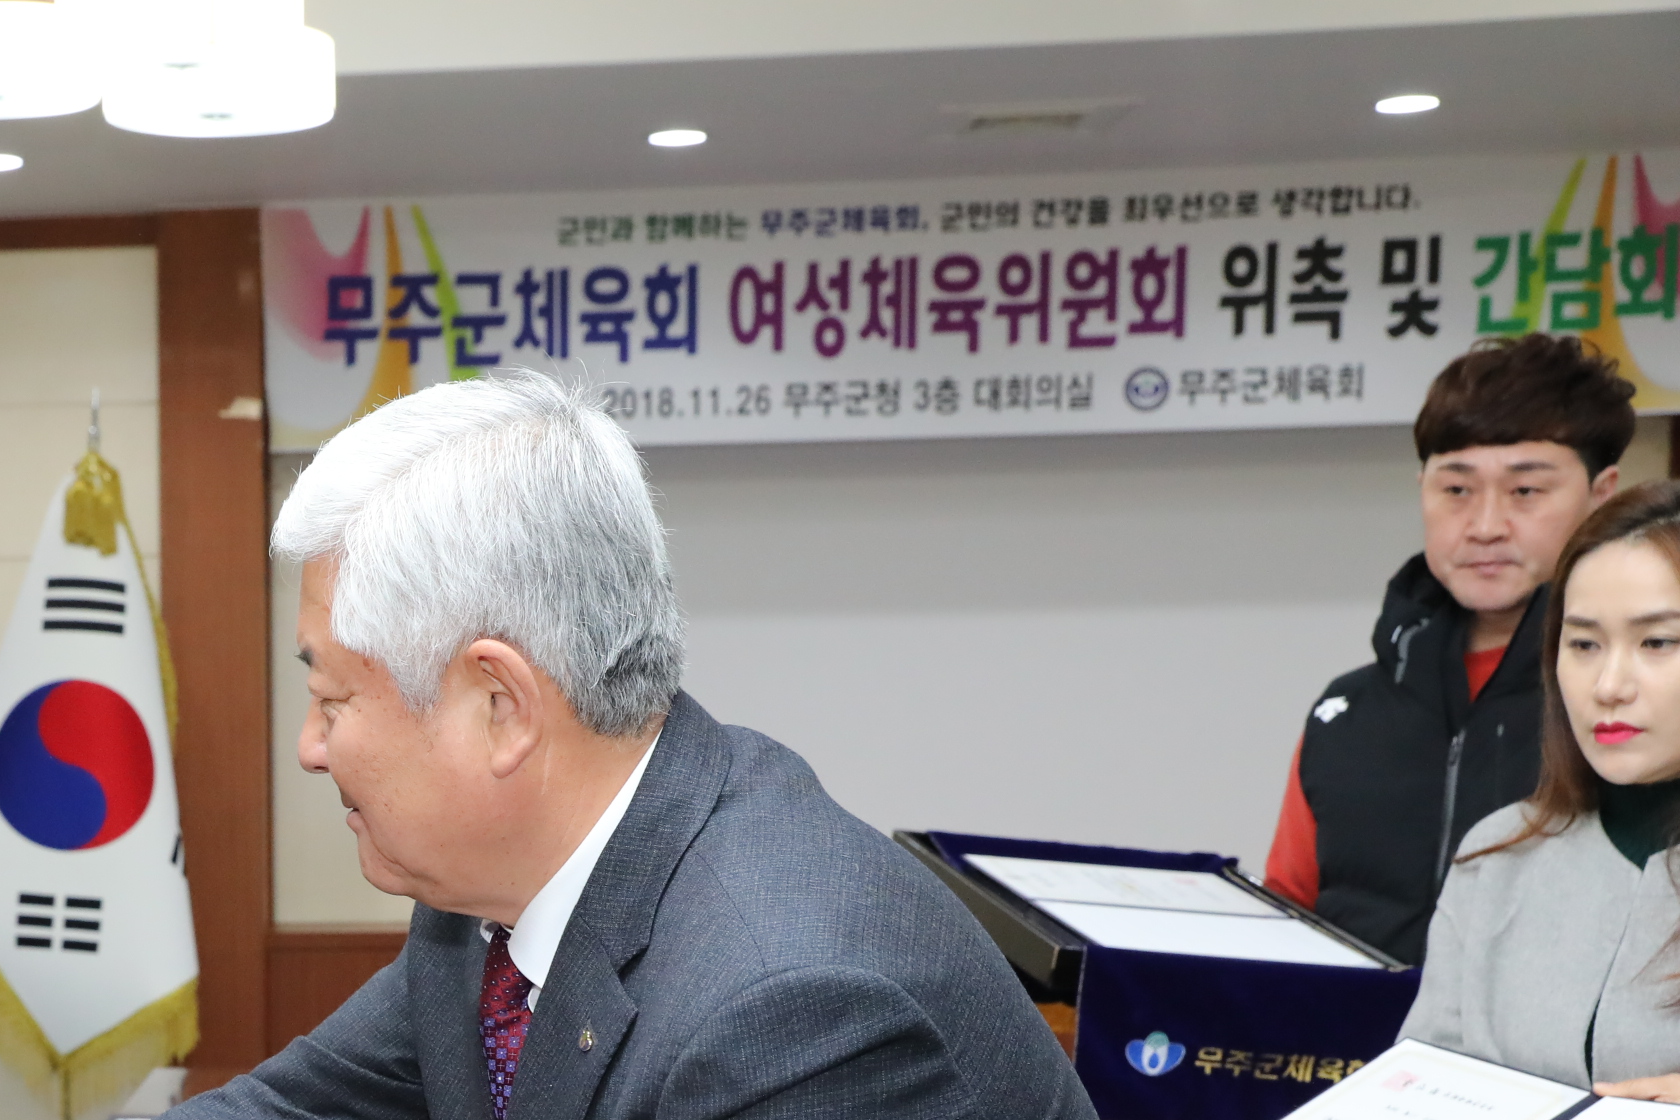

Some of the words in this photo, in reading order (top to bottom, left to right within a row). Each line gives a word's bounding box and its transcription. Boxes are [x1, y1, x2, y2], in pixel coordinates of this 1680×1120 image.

[558, 213, 634, 248] 군민과
[645, 211, 749, 245] 함께하는
[939, 200, 1020, 234] 군민의
[1031, 194, 1110, 230] 건강을
[1123, 188, 1260, 225] 최우선으로
[323, 262, 699, 367] 무주군체육회
[728, 243, 1189, 359] 여성체육위원회
[1219, 233, 1349, 341] 위촉
[1379, 233, 1442, 338] 및
[1472, 222, 1680, 334] 간담회
[603, 382, 773, 421] 2018.11.26
[782, 376, 902, 419] 무주군청
[913, 374, 961, 416] 3층
[972, 370, 1095, 412] 대회의실
[1178, 362, 1365, 407] 무주군체육회
